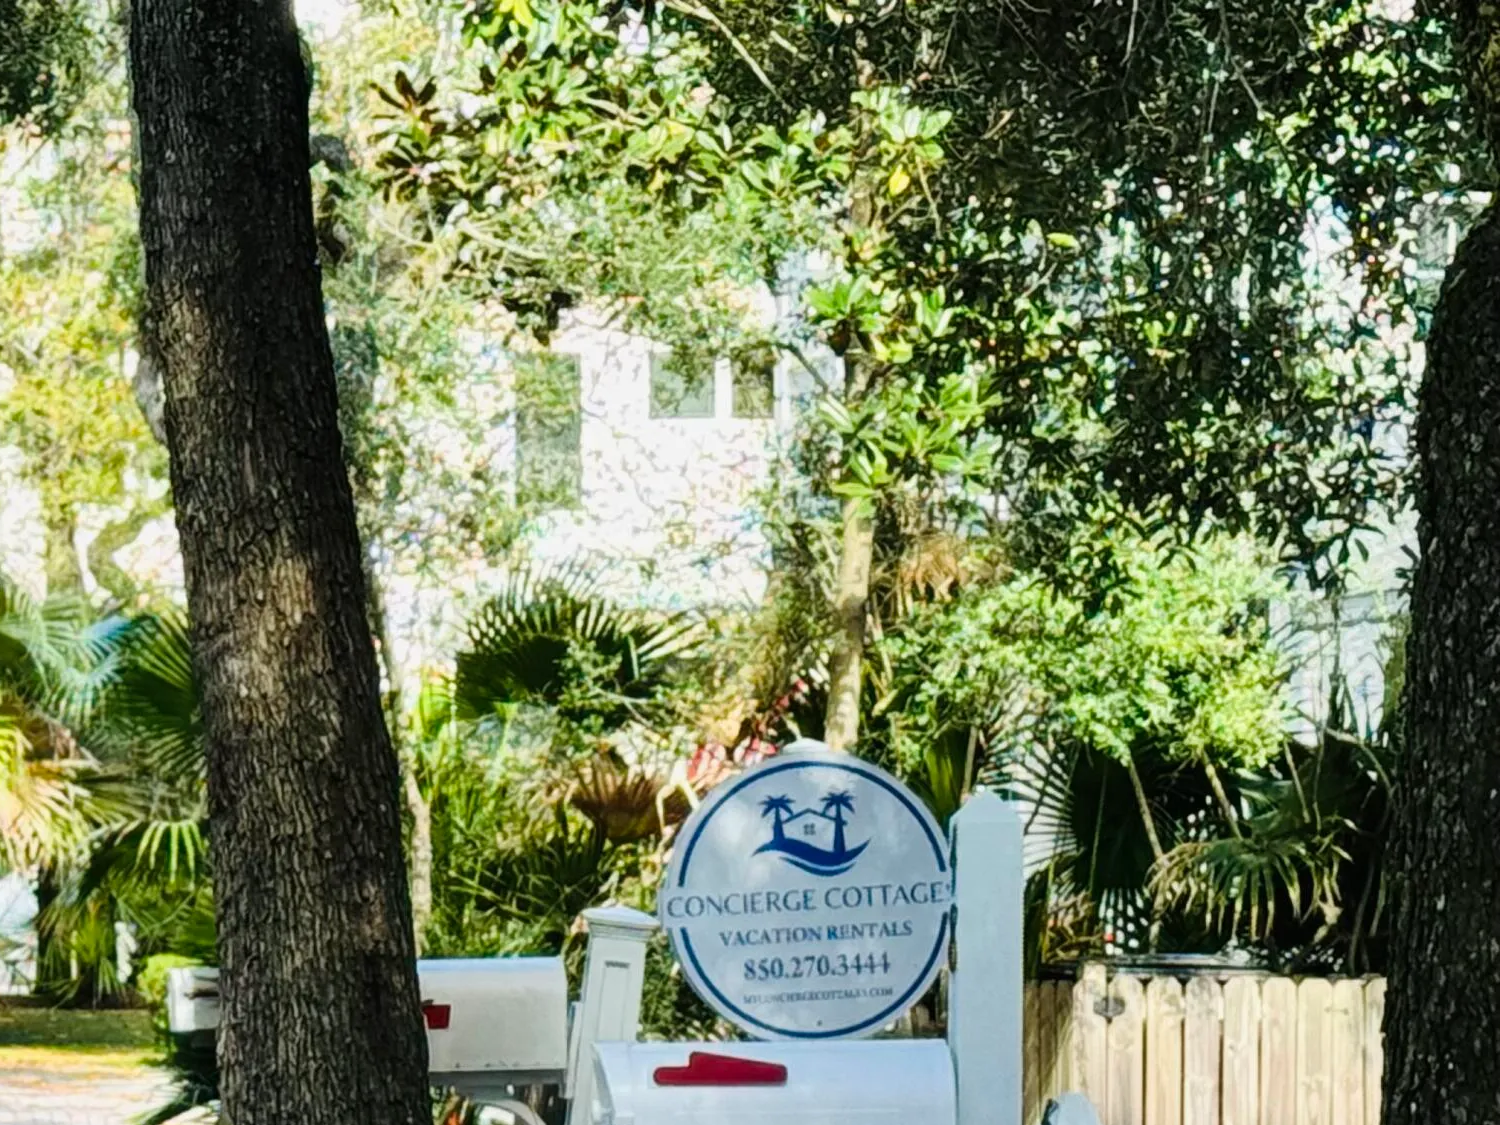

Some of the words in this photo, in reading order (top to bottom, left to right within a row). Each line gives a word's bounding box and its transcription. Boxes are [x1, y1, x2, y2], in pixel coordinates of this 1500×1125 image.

[667, 889, 817, 917] CONCIERGE
[719, 925, 822, 947] VACATION
[827, 920, 913, 940] RENTALS
[744, 951, 890, 981] 850.270.3444
